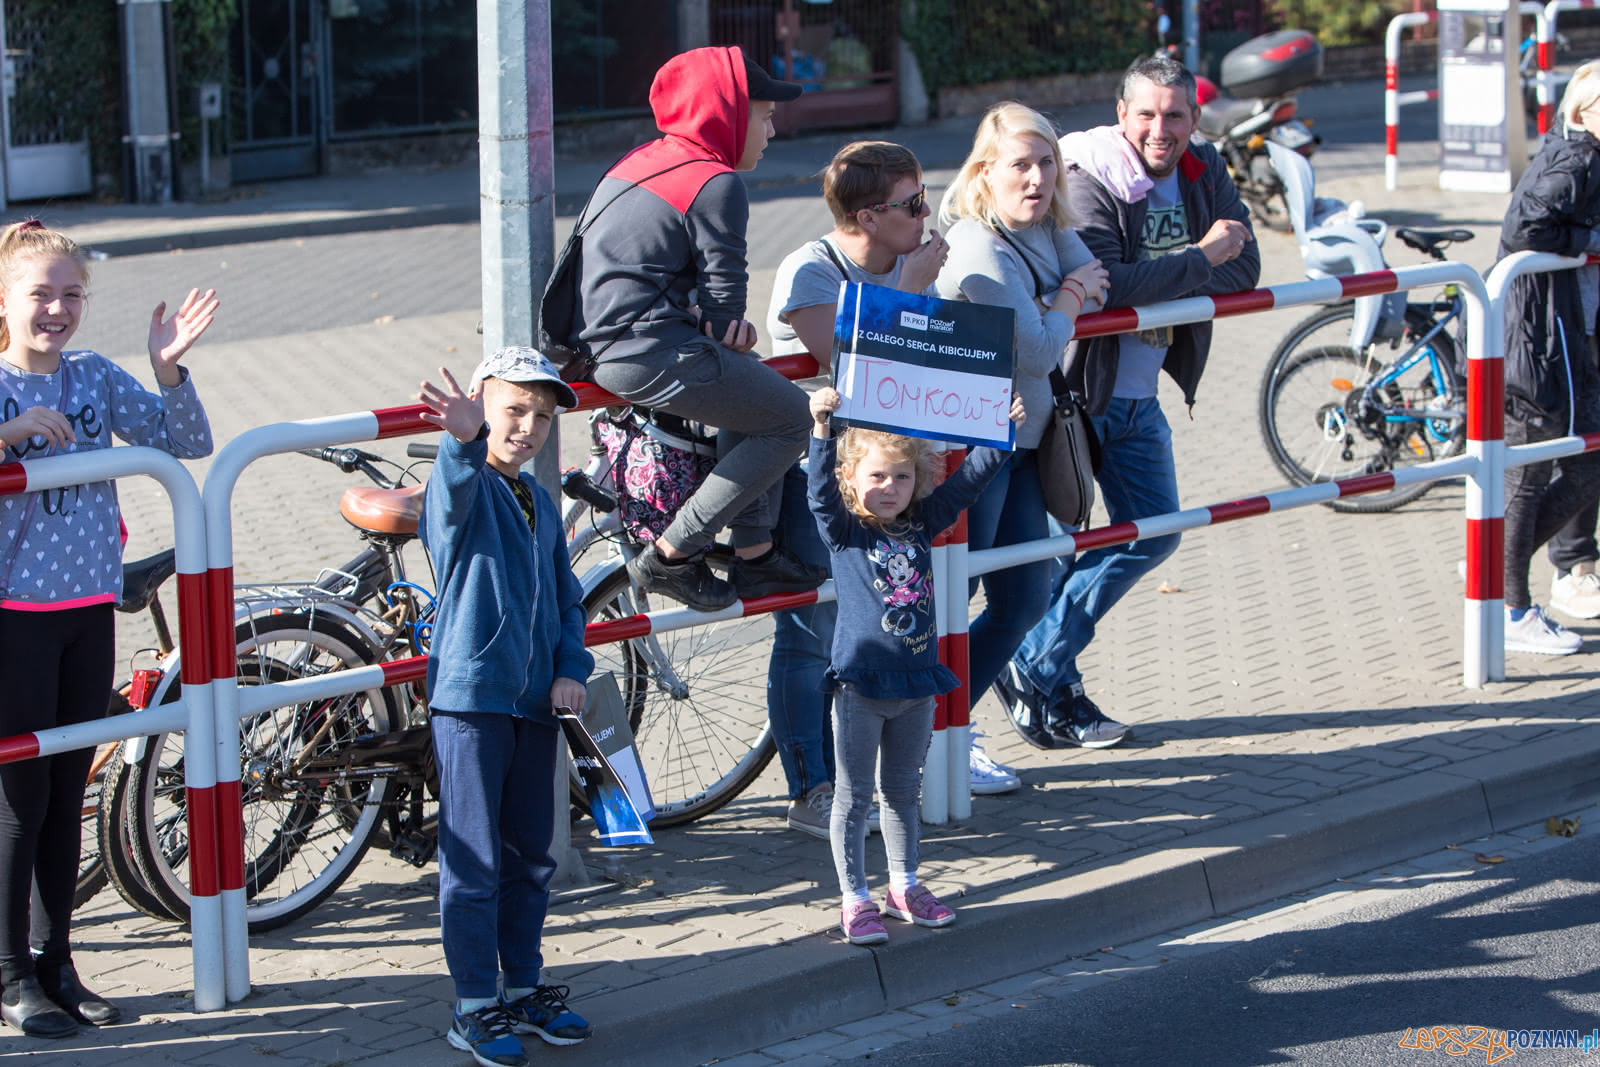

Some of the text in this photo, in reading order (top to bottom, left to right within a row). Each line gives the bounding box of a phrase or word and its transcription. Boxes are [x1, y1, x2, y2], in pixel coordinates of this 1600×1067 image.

[858, 329, 997, 361] Z CAŁEGO SERCA KIBICUJEMY
